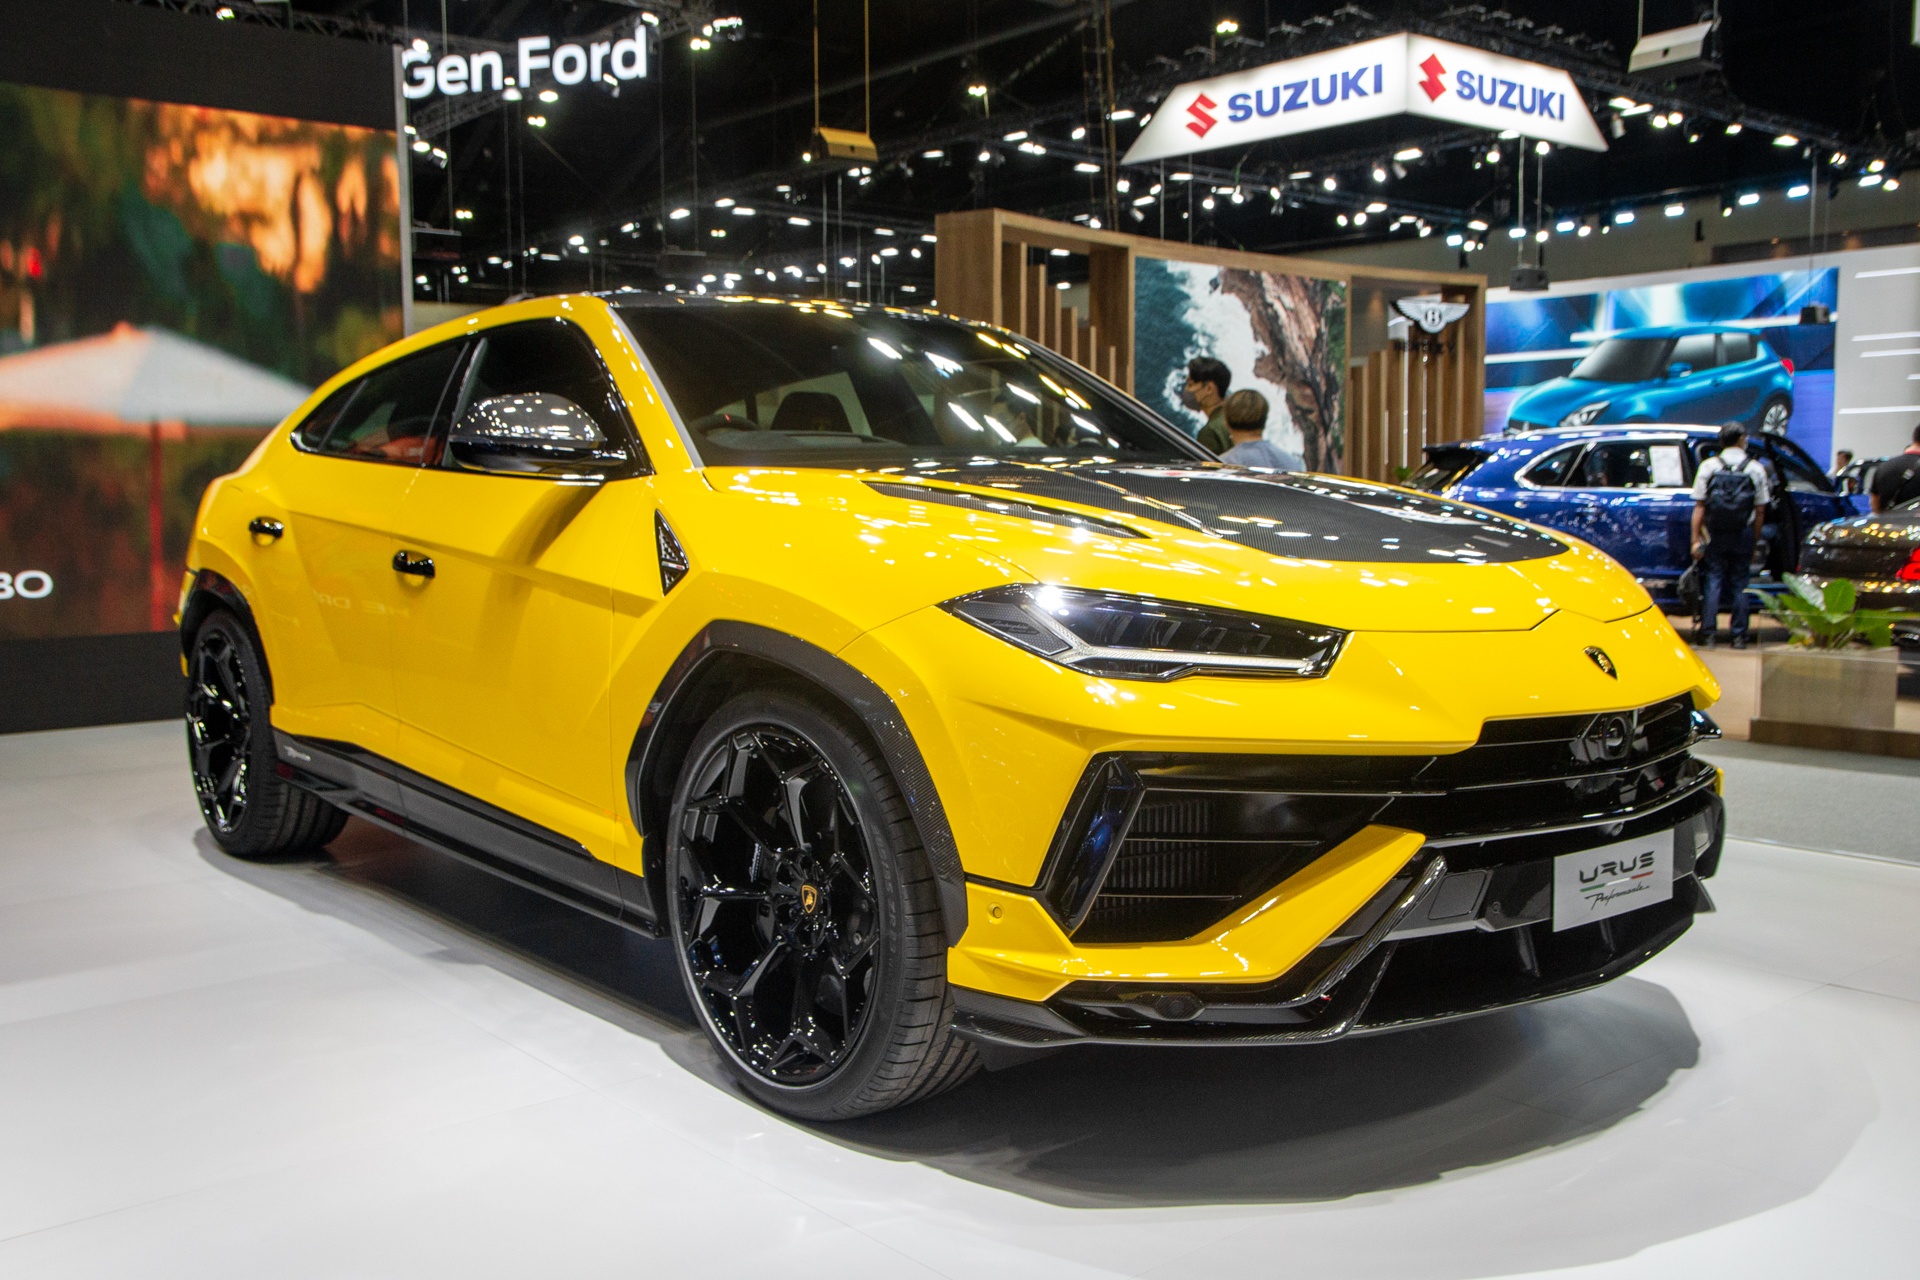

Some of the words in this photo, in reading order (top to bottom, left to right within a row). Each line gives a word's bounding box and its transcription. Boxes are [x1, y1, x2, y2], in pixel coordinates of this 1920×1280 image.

[518, 25, 648, 89] Ford
[1228, 64, 1383, 123] SUZUKI
[1456, 69, 1565, 121] SUZUKI
[1579, 850, 1655, 884] URUS
